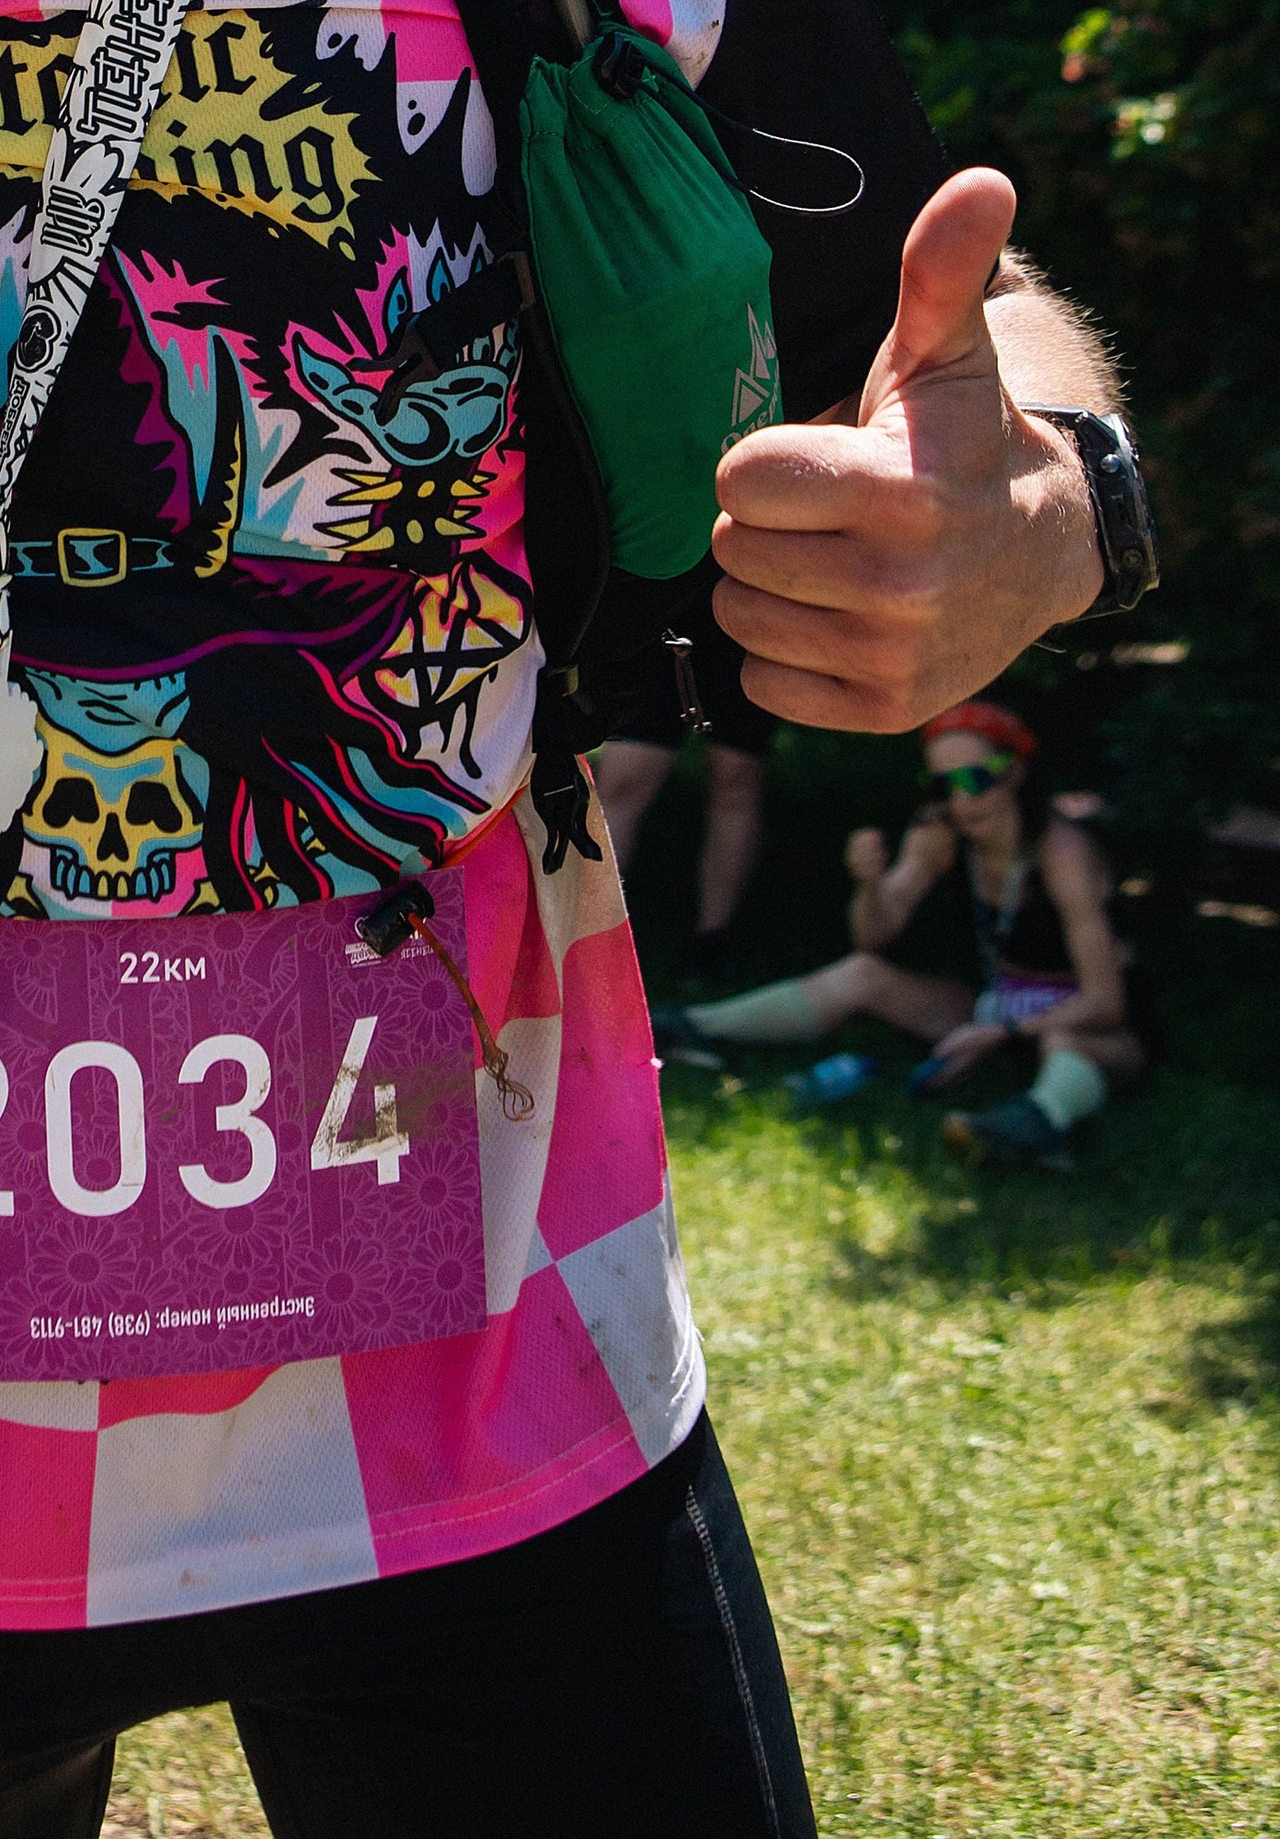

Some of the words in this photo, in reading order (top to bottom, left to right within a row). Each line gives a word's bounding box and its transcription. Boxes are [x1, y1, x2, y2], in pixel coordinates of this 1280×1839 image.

[107, 1309, 151, 1339] (938)
[155, 1305, 212, 1329] номер:
[216, 1295, 316, 1330] Экстренный
[29, 1315, 103, 1339] 481-9113
